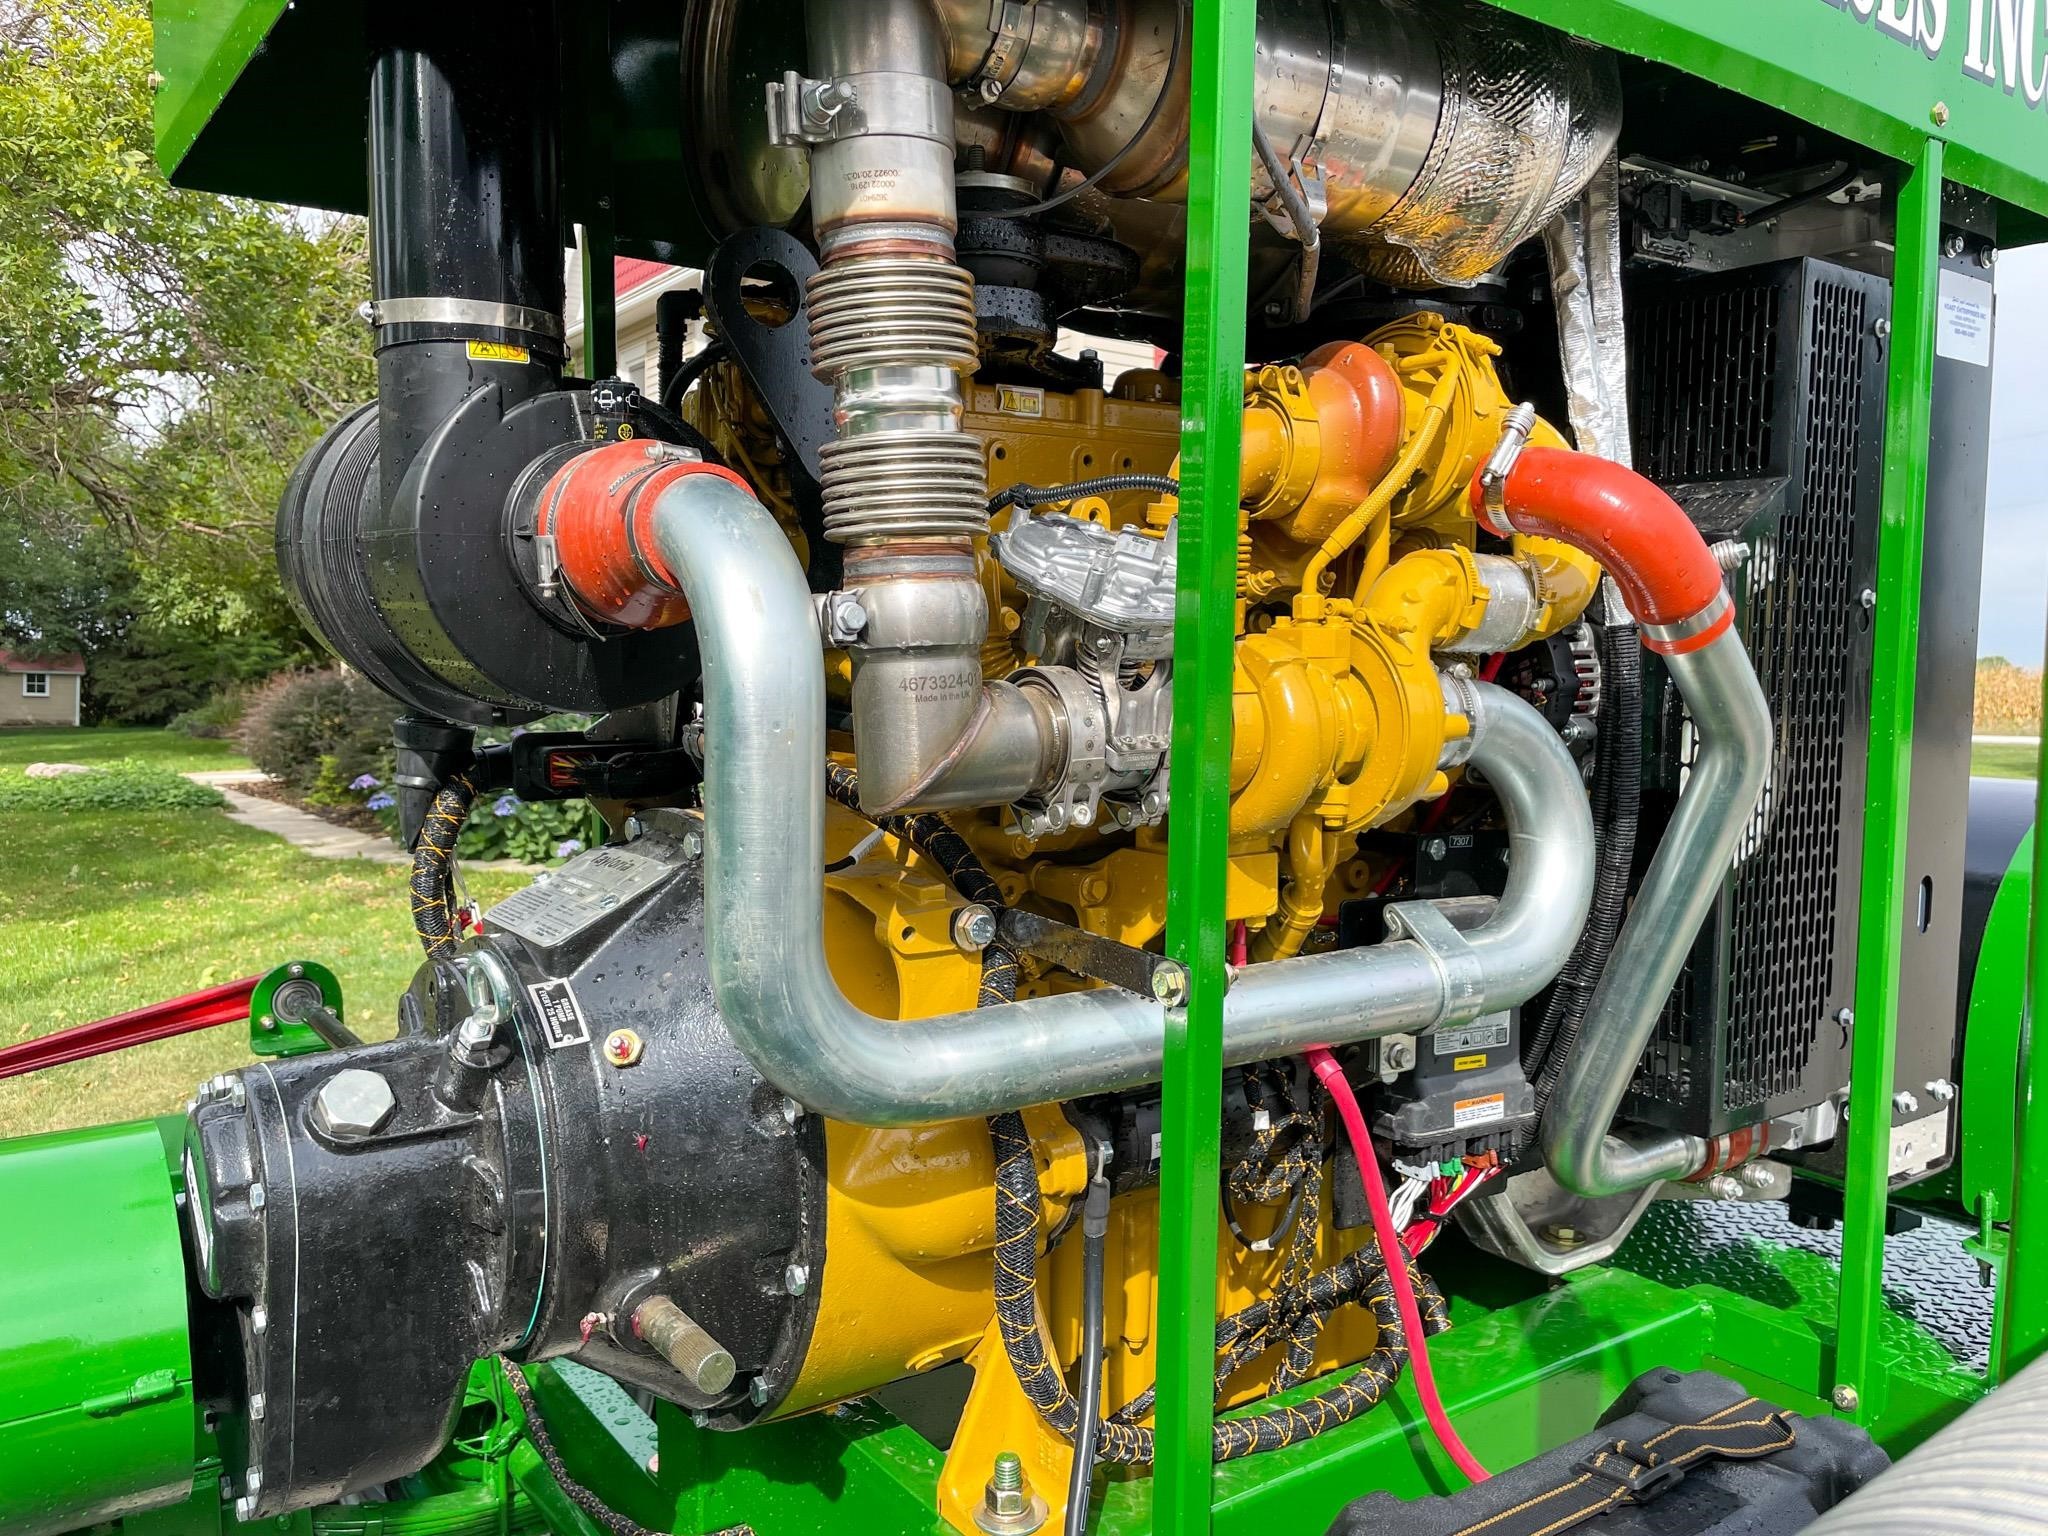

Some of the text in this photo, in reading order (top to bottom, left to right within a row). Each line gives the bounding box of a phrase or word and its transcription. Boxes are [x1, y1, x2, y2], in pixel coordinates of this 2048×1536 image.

[915, 694, 938, 703] Made
[940, 693, 948, 702] in
[539, 990, 564, 1039] EVERY 25 HOURS
[553, 1003, 568, 1023] PUMP
[560, 997, 576, 1022] GREASE
